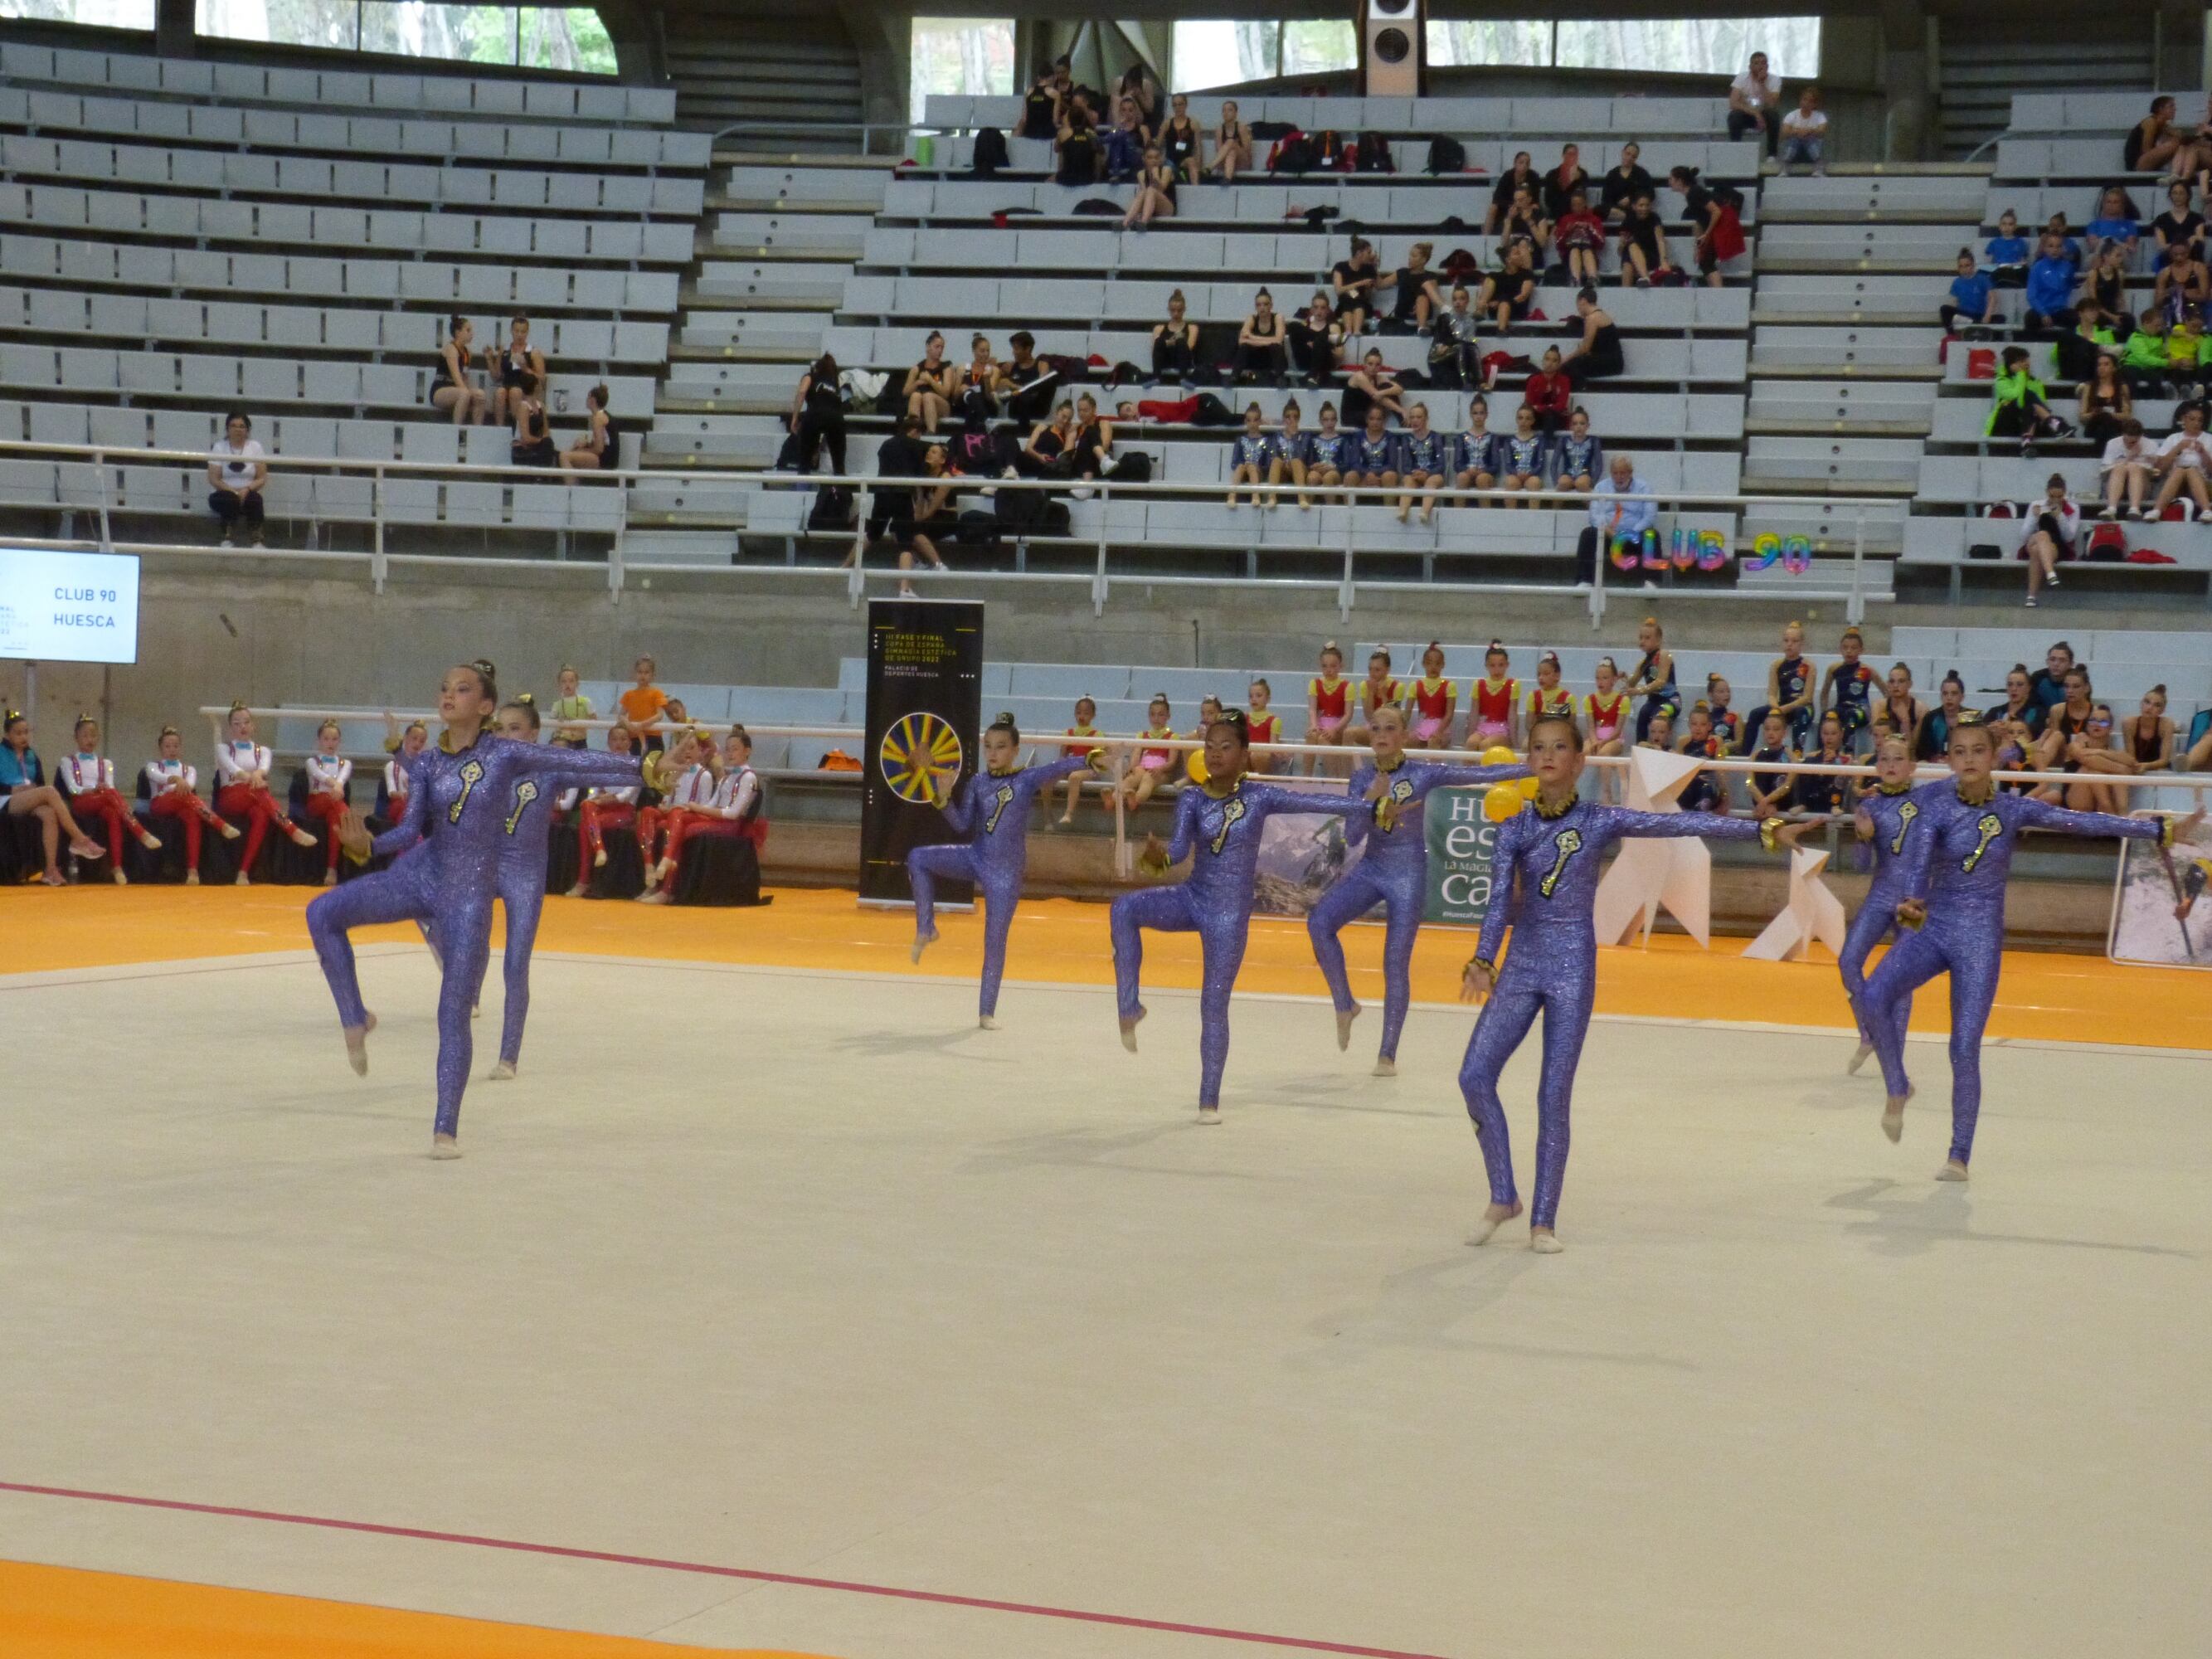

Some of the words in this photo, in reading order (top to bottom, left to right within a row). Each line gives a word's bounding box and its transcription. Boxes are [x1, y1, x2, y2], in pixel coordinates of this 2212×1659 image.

[1610, 528, 1726, 572] CLUB
[1744, 532, 1810, 575] 90
[54, 587, 95, 601] CLUB
[100, 590, 117, 602] 90
[53, 614, 115, 628] HUESCA
[1441, 874, 1491, 906] ca
